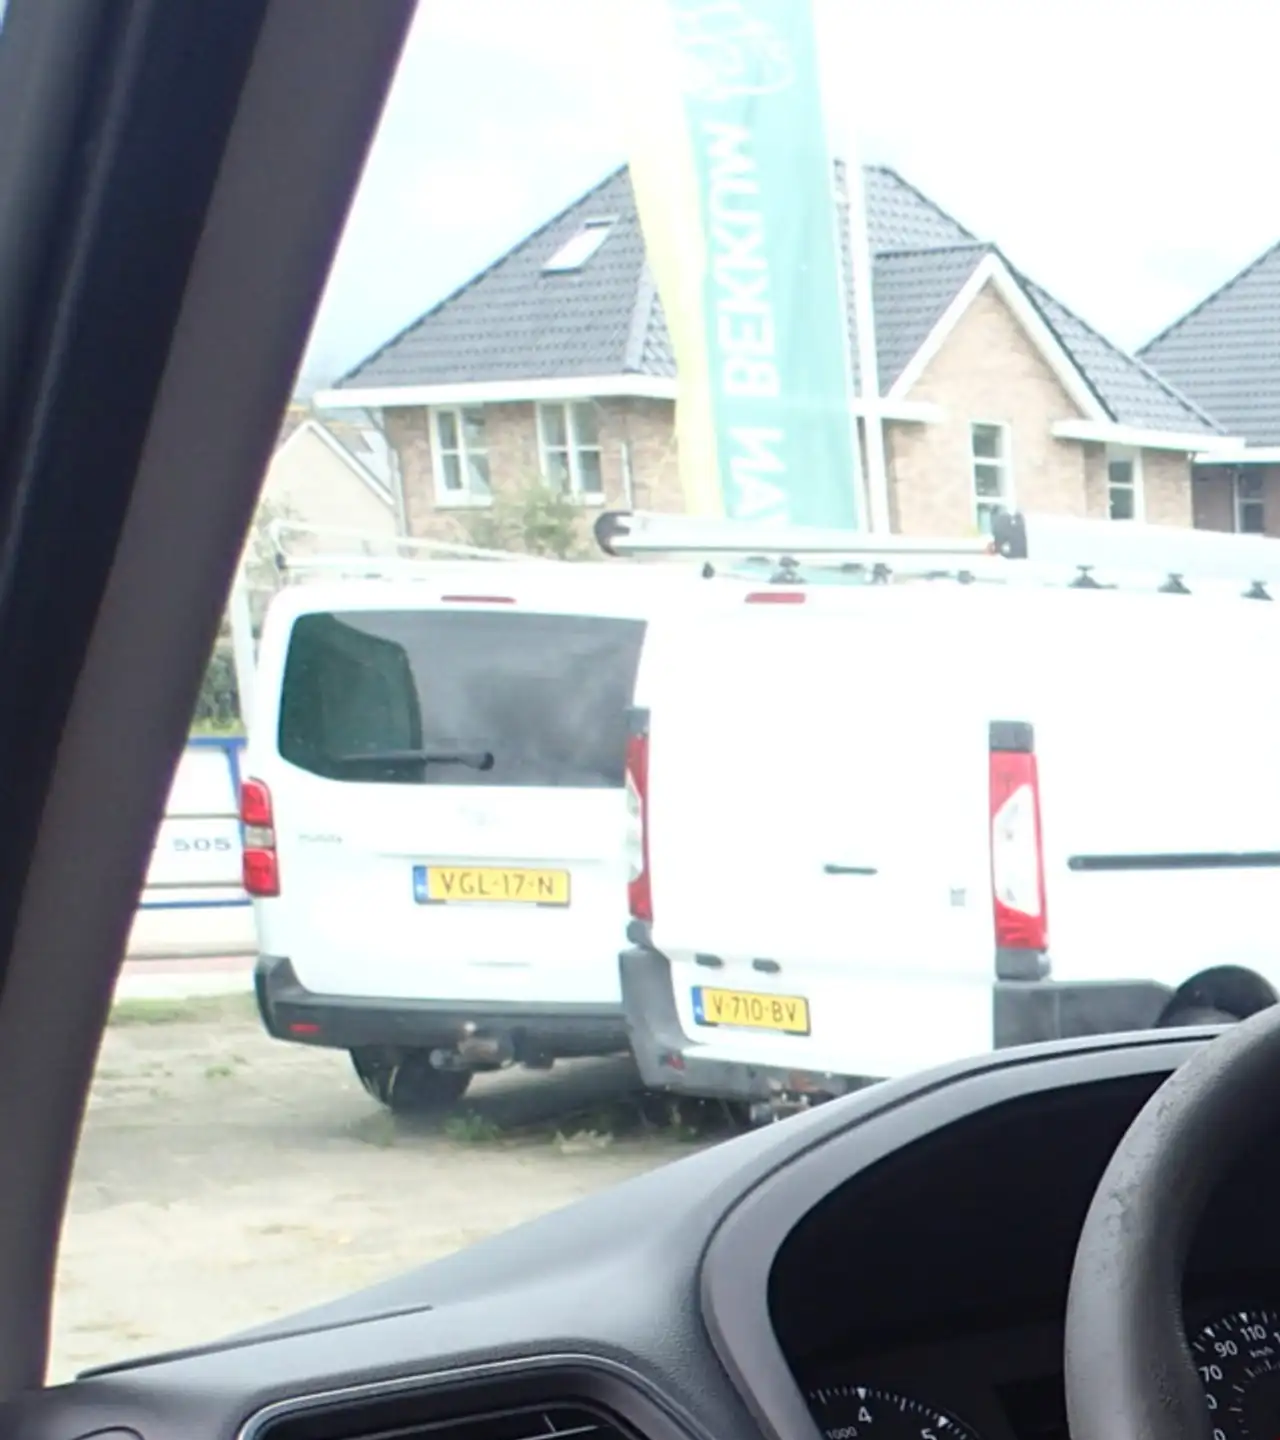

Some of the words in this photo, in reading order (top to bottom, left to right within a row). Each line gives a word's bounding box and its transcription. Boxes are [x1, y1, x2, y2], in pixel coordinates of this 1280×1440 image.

[173, 838, 232, 852] 505
[440, 872, 555, 897] VGL-17-N
[712, 995, 796, 1023] V-710-BV
[1240, 1325, 1267, 1342] 110
[1214, 1340, 1238, 1358] 90
[1199, 1364, 1224, 1383] 70
[856, 1406, 873, 1424] 4
